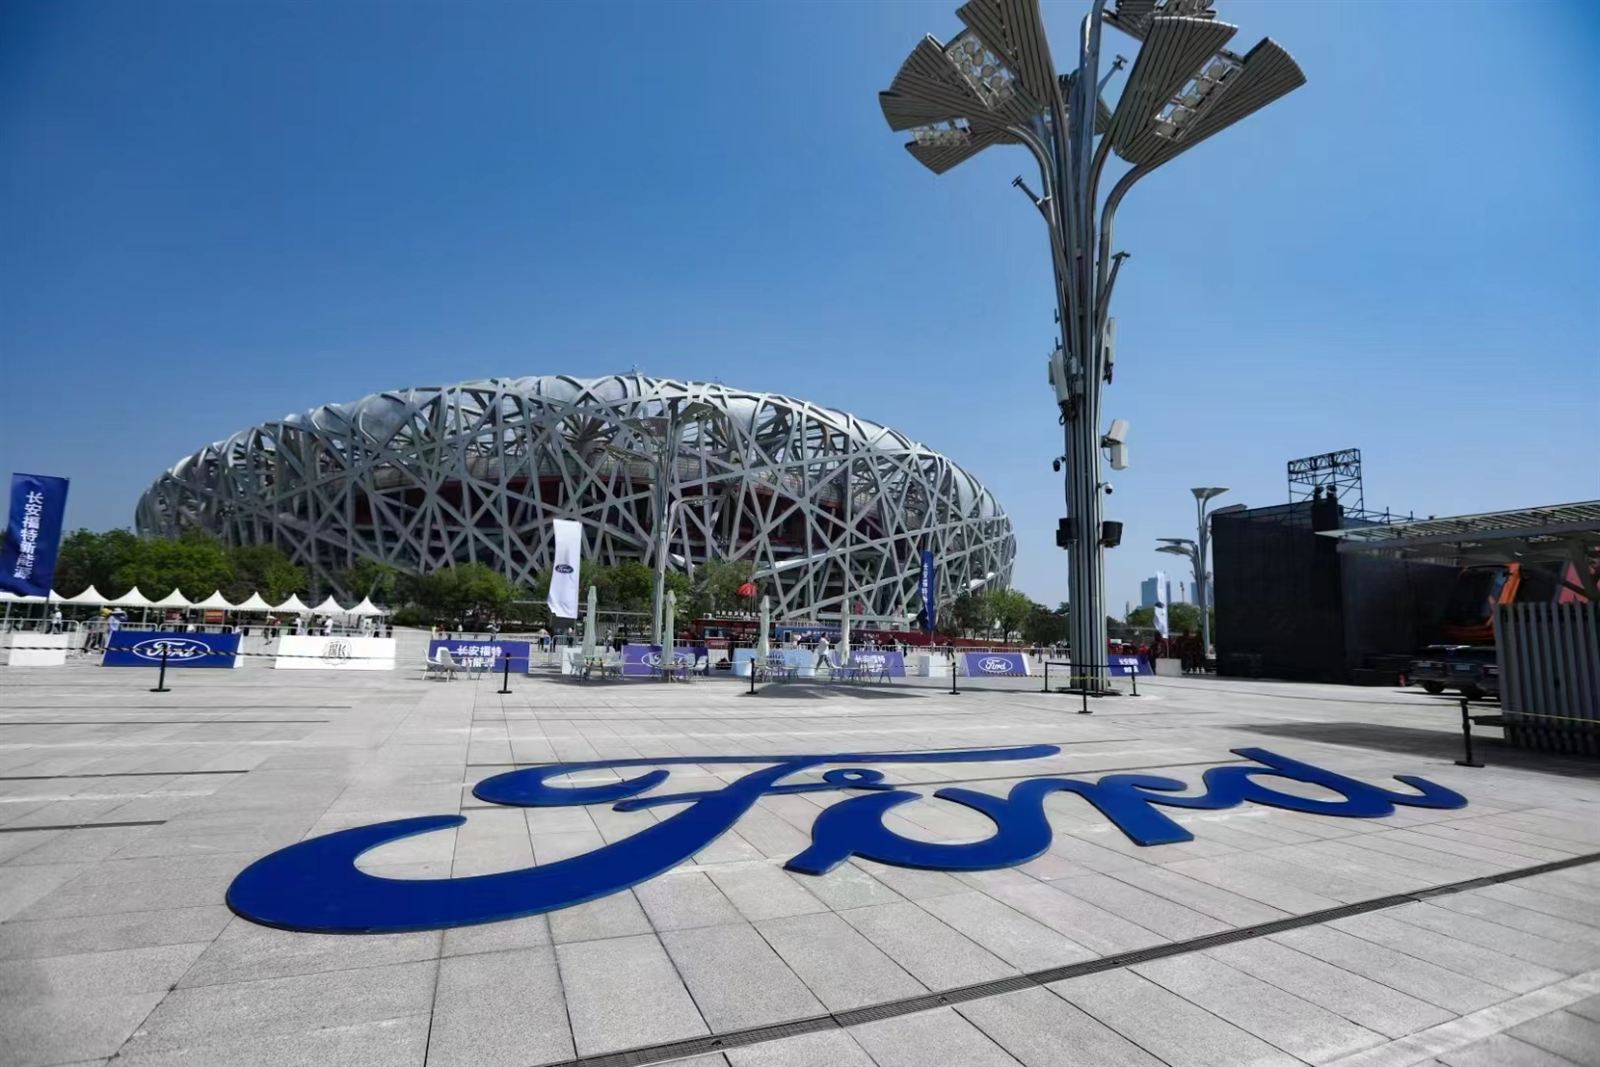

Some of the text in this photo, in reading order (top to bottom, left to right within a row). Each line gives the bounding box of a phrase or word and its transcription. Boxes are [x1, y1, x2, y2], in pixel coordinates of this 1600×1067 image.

[146, 640, 197, 657] Ford
[984, 658, 1007, 671] Ford
[226, 744, 1467, 934] Ford
